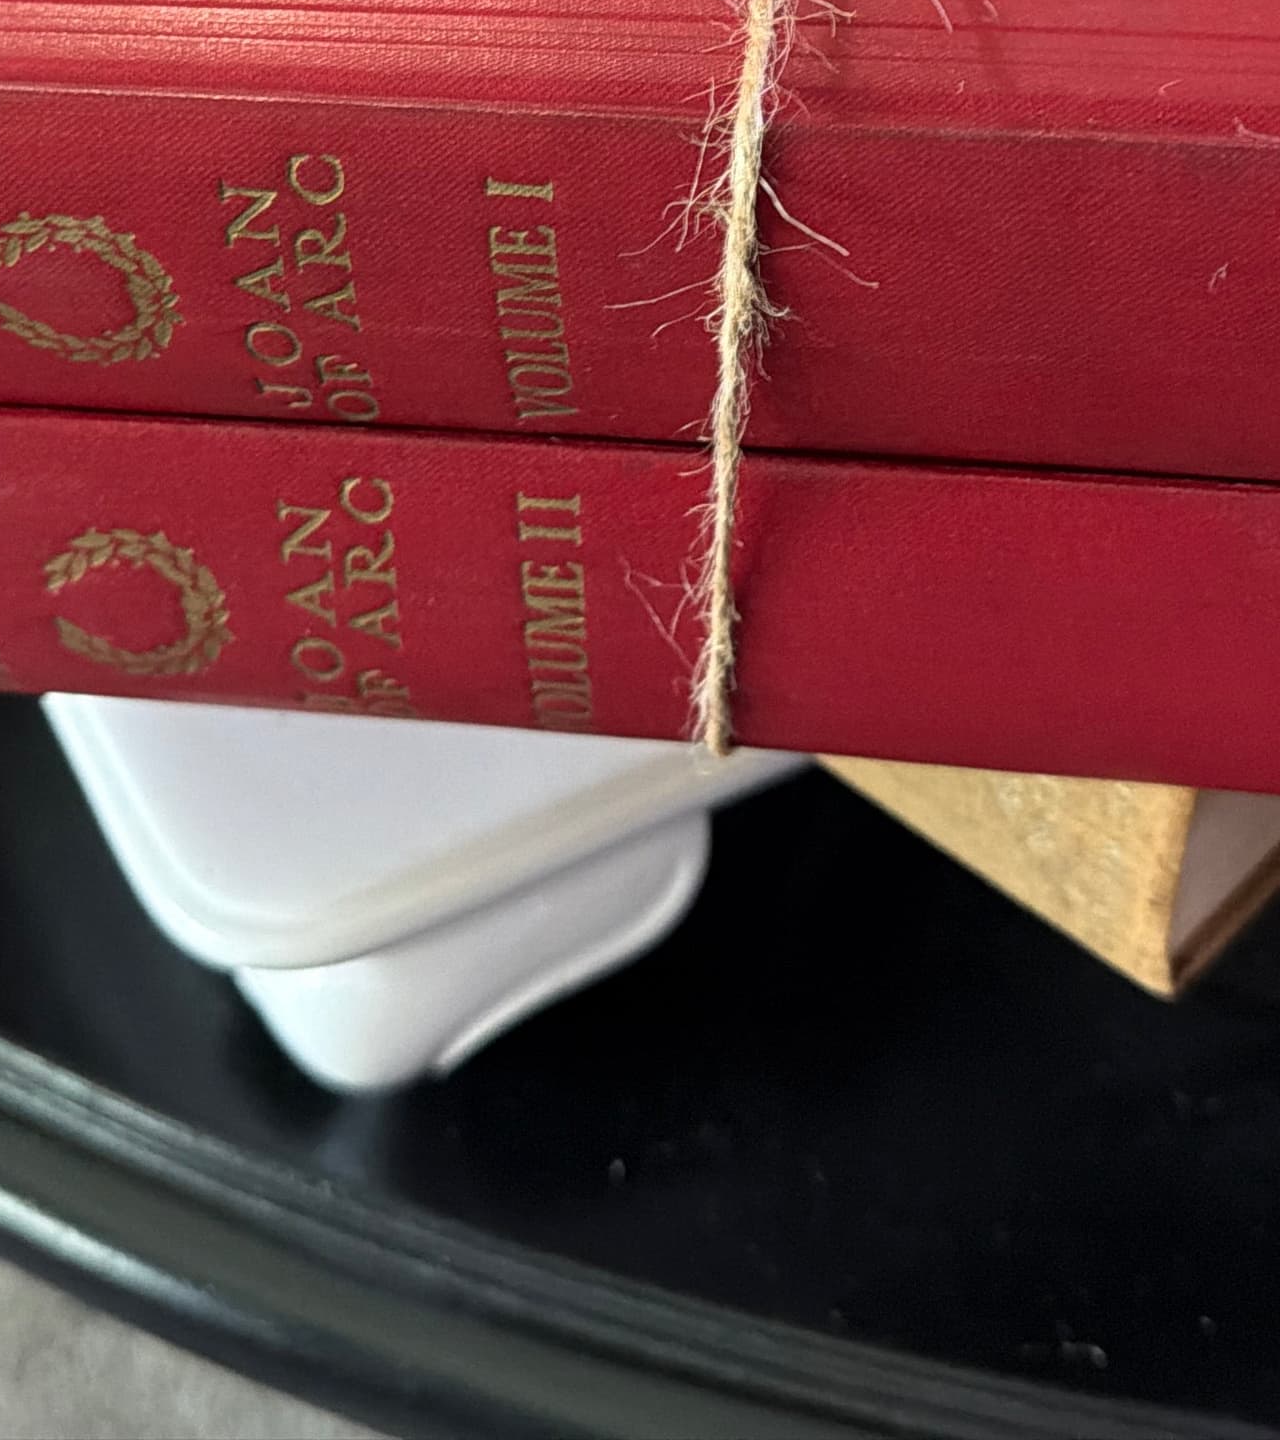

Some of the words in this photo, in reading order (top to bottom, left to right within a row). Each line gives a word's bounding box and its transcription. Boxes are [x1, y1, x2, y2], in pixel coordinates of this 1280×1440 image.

[287, 153, 363, 333] ARC
[485, 175, 555, 203] I
[219, 179, 314, 408] JOAN
[489, 224, 580, 420] VOLUME
[317, 354, 381, 423] OF
[338, 475, 403, 652] ARC
[517, 491, 583, 548] II
[520, 560, 593, 727] OLUME
